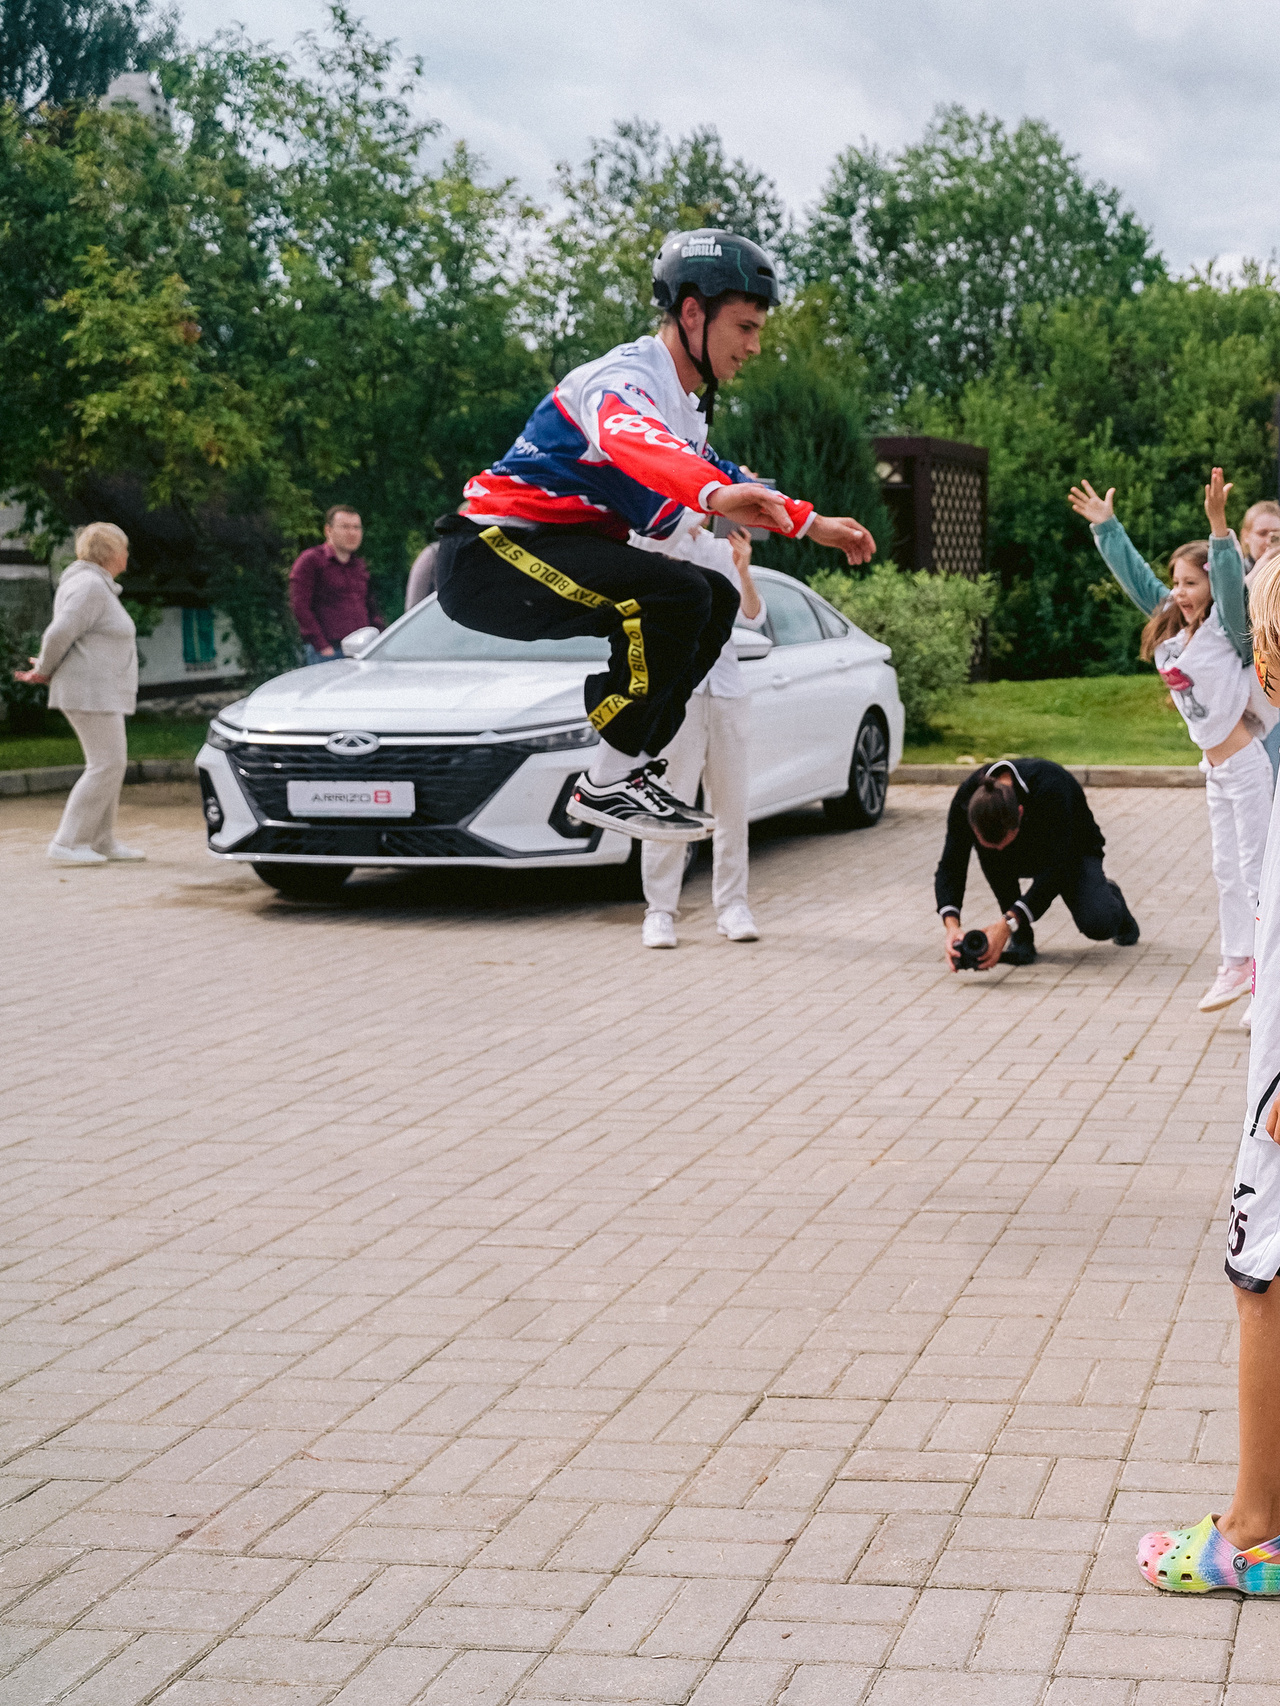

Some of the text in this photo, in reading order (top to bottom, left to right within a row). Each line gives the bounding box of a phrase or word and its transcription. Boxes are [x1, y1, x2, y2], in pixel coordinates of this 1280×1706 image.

[681, 244, 722, 258] GORILLA
[529, 562, 571, 592] BIDLO
[629, 630, 646, 673] BIDLO
[374, 790, 392, 804] 8
